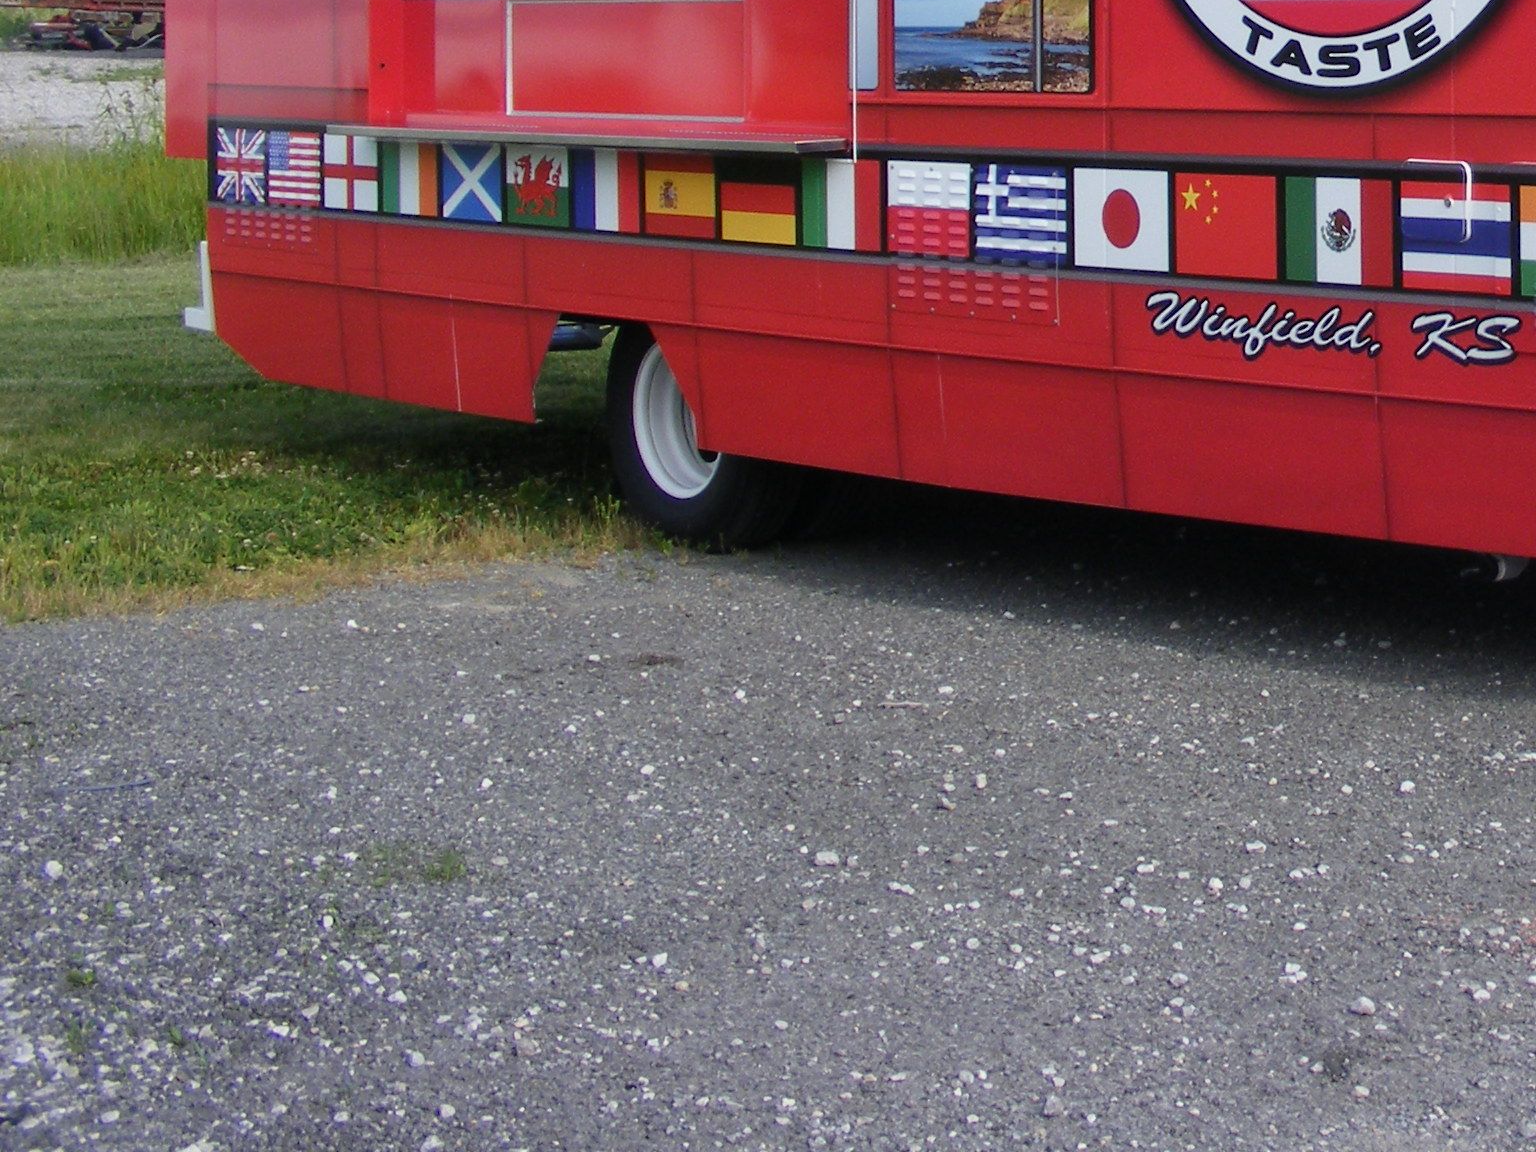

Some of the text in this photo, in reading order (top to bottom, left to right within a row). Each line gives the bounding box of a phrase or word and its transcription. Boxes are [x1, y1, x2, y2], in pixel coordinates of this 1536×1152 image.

[1241, 13, 1443, 79] TASTE
[1146, 291, 1521, 366] Winfield, KS
